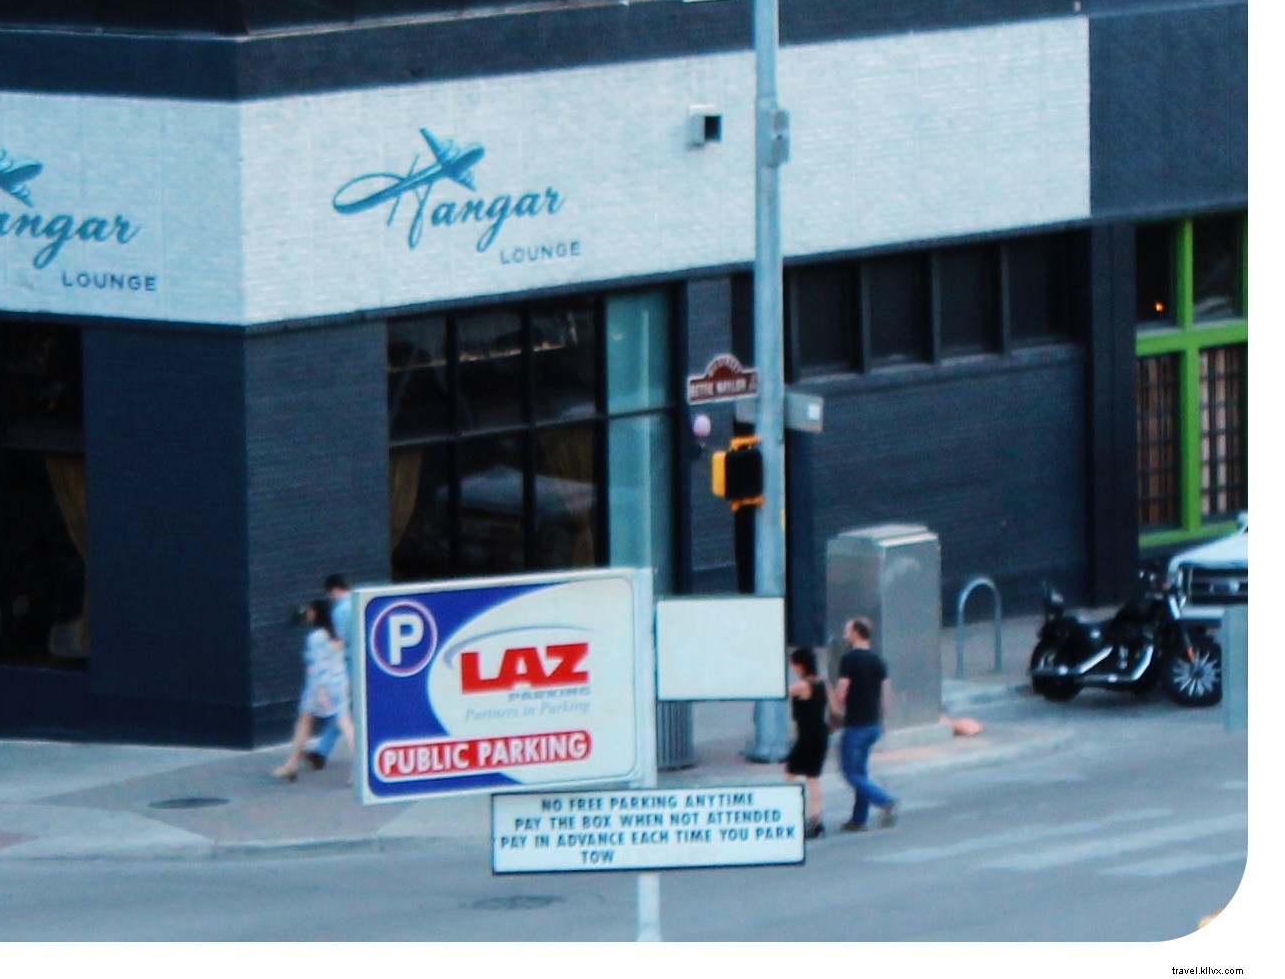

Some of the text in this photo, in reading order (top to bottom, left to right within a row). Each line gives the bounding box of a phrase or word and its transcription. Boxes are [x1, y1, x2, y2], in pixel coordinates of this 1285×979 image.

[333, 128, 565, 252] Hangar
[500, 240, 582, 264] LOUNGE
[62, 271, 157, 291] LOUNGE
[388, 614, 425, 666] P
[460, 642, 590, 695] LAZ
[507, 686, 591, 702] PARKING
[465, 698, 590, 721] Partners in Parking
[383, 731, 588, 775] PUBLIC PARKING
[541, 793, 755, 812] NO FREE PARKING ANYTIME
[515, 809, 781, 831] PAY THE BOX WHEN NOT ATTENDED
[501, 826, 796, 849] PAY IN ADVANCE EACH TIME YOU PARK
[581, 850, 615, 864] TOW
